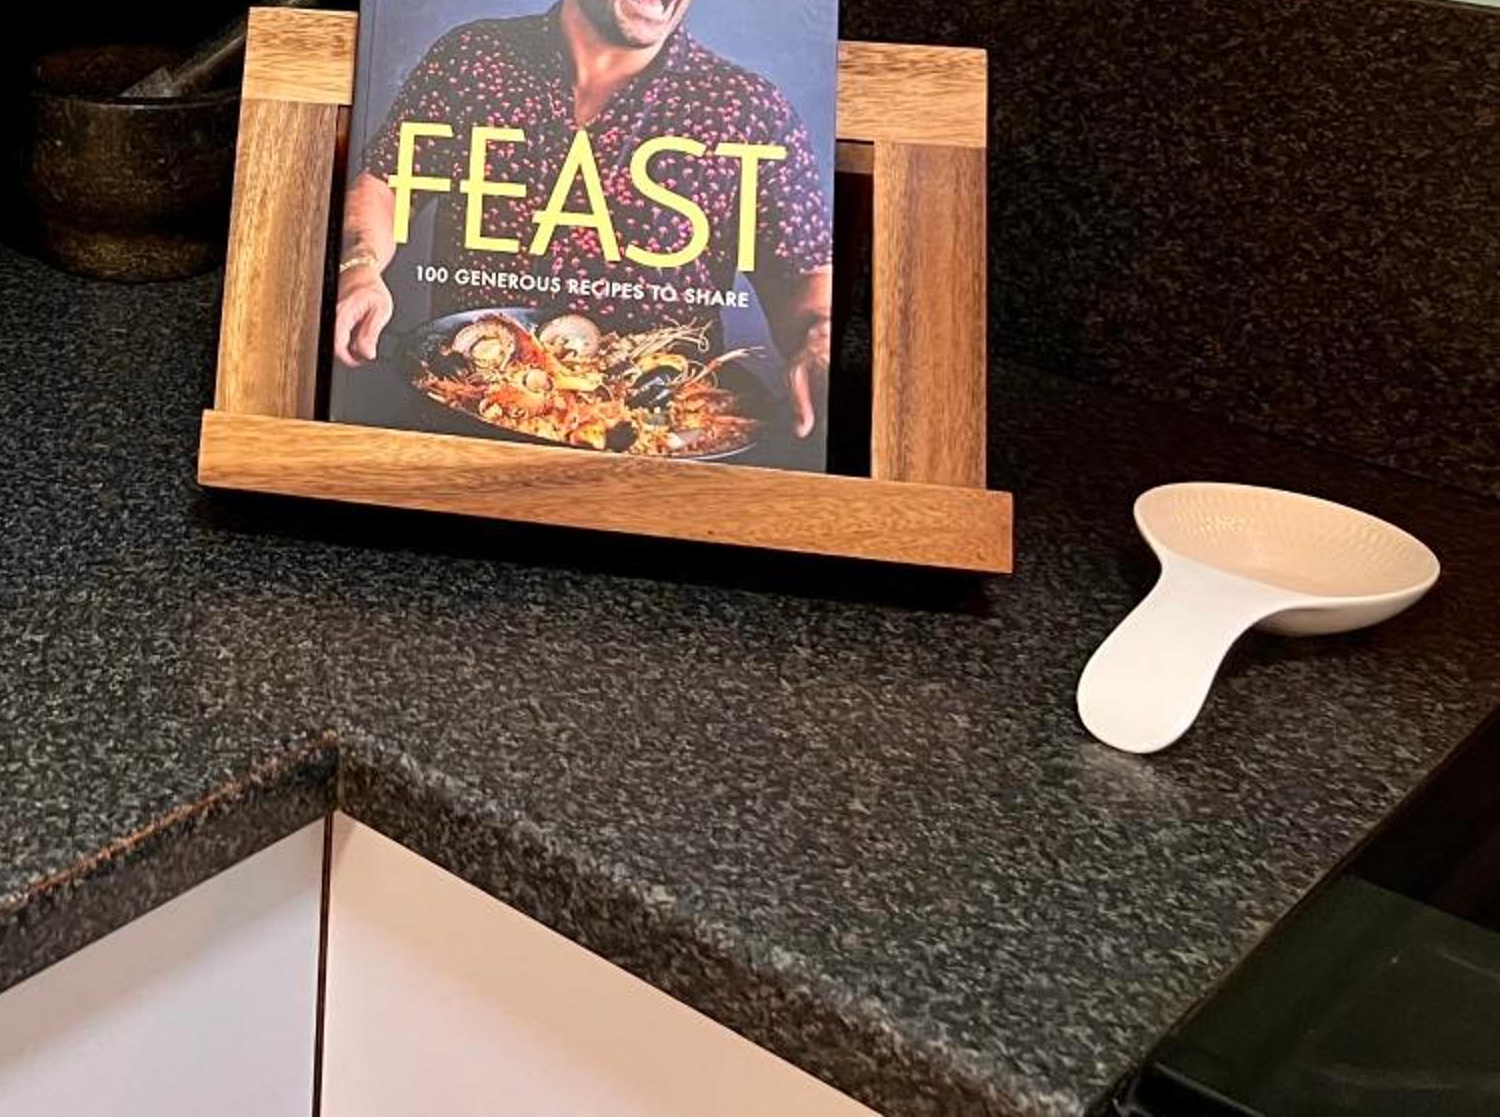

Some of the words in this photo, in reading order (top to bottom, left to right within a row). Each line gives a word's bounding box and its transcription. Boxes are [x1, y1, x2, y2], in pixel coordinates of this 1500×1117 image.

[387, 121, 788, 272] FEAST
[415, 265, 449, 283] 100
[454, 268, 562, 292] GENEROUS
[567, 278, 645, 300] RECIPES
[649, 284, 678, 302] TO
[684, 287, 750, 308] SHARE
